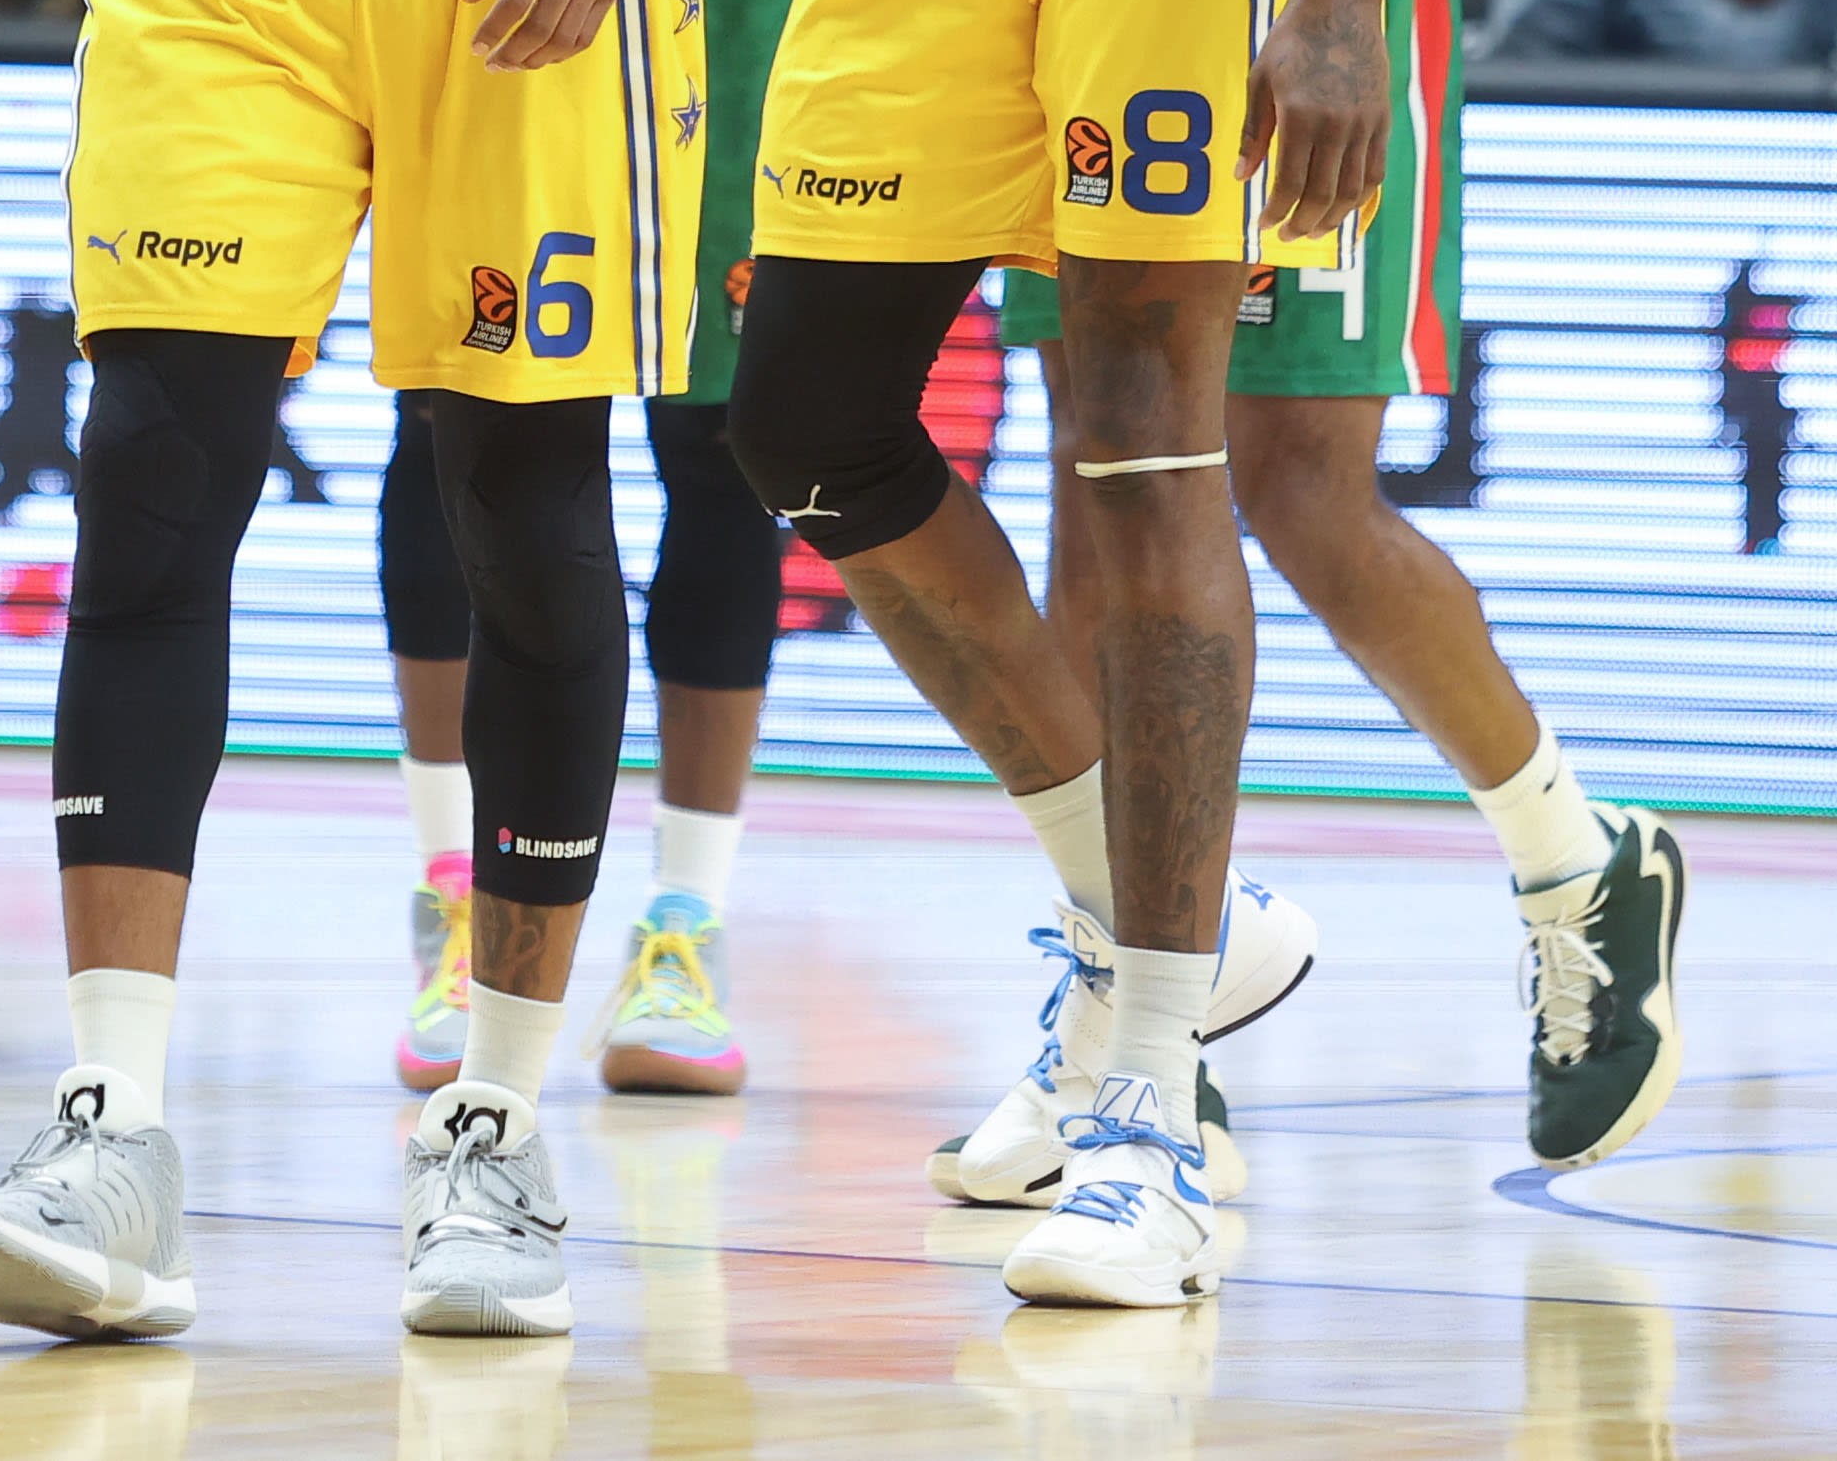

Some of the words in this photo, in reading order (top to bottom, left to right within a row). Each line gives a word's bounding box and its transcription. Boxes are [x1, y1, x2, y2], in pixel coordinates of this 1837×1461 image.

[1121, 88, 1213, 216] 8
[795, 168, 903, 207] Rapyd
[1069, 184, 1109, 197] AIRLINES
[1071, 174, 1110, 188] TURKISH
[136, 230, 244, 269] Rapyd
[525, 231, 596, 358] 6
[471, 329, 509, 347] AIRLINES
[476, 320, 512, 337] TURKISH
[515, 835, 599, 859] BLINDSAVE
